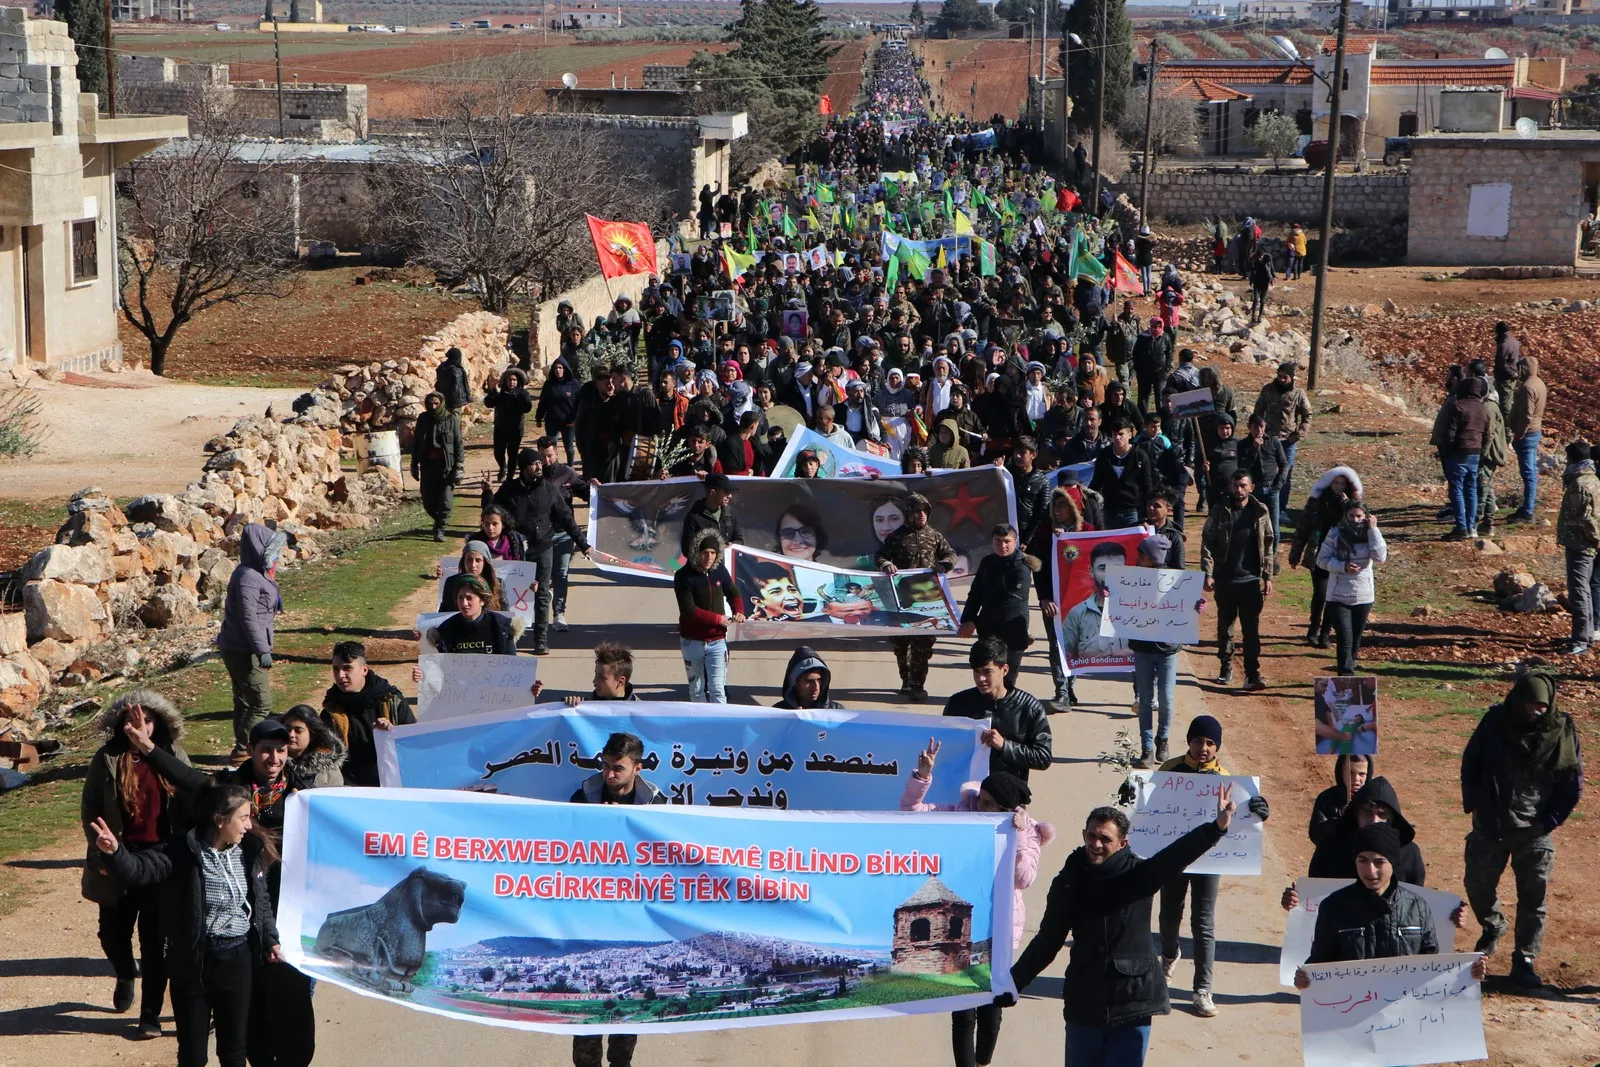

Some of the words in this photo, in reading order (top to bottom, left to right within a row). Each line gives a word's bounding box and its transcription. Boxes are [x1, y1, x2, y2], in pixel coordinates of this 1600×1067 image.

[456, 641, 485, 650] GUCCI
[1090, 655, 1124, 665] Behdinan
[480, 739, 563, 780] العصر
[670, 744, 750, 776] وتيرة
[756, 748, 795, 775] من
[1162, 776, 1195, 792] APO
[363, 832, 405, 857] EM
[411, 830, 429, 857] Ê
[434, 837, 630, 866] BERXWEDANA
[634, 840, 763, 869] SERDEMÊ
[680, 873, 732, 902] TÊK
[1313, 990, 1378, 1013] الحرب
